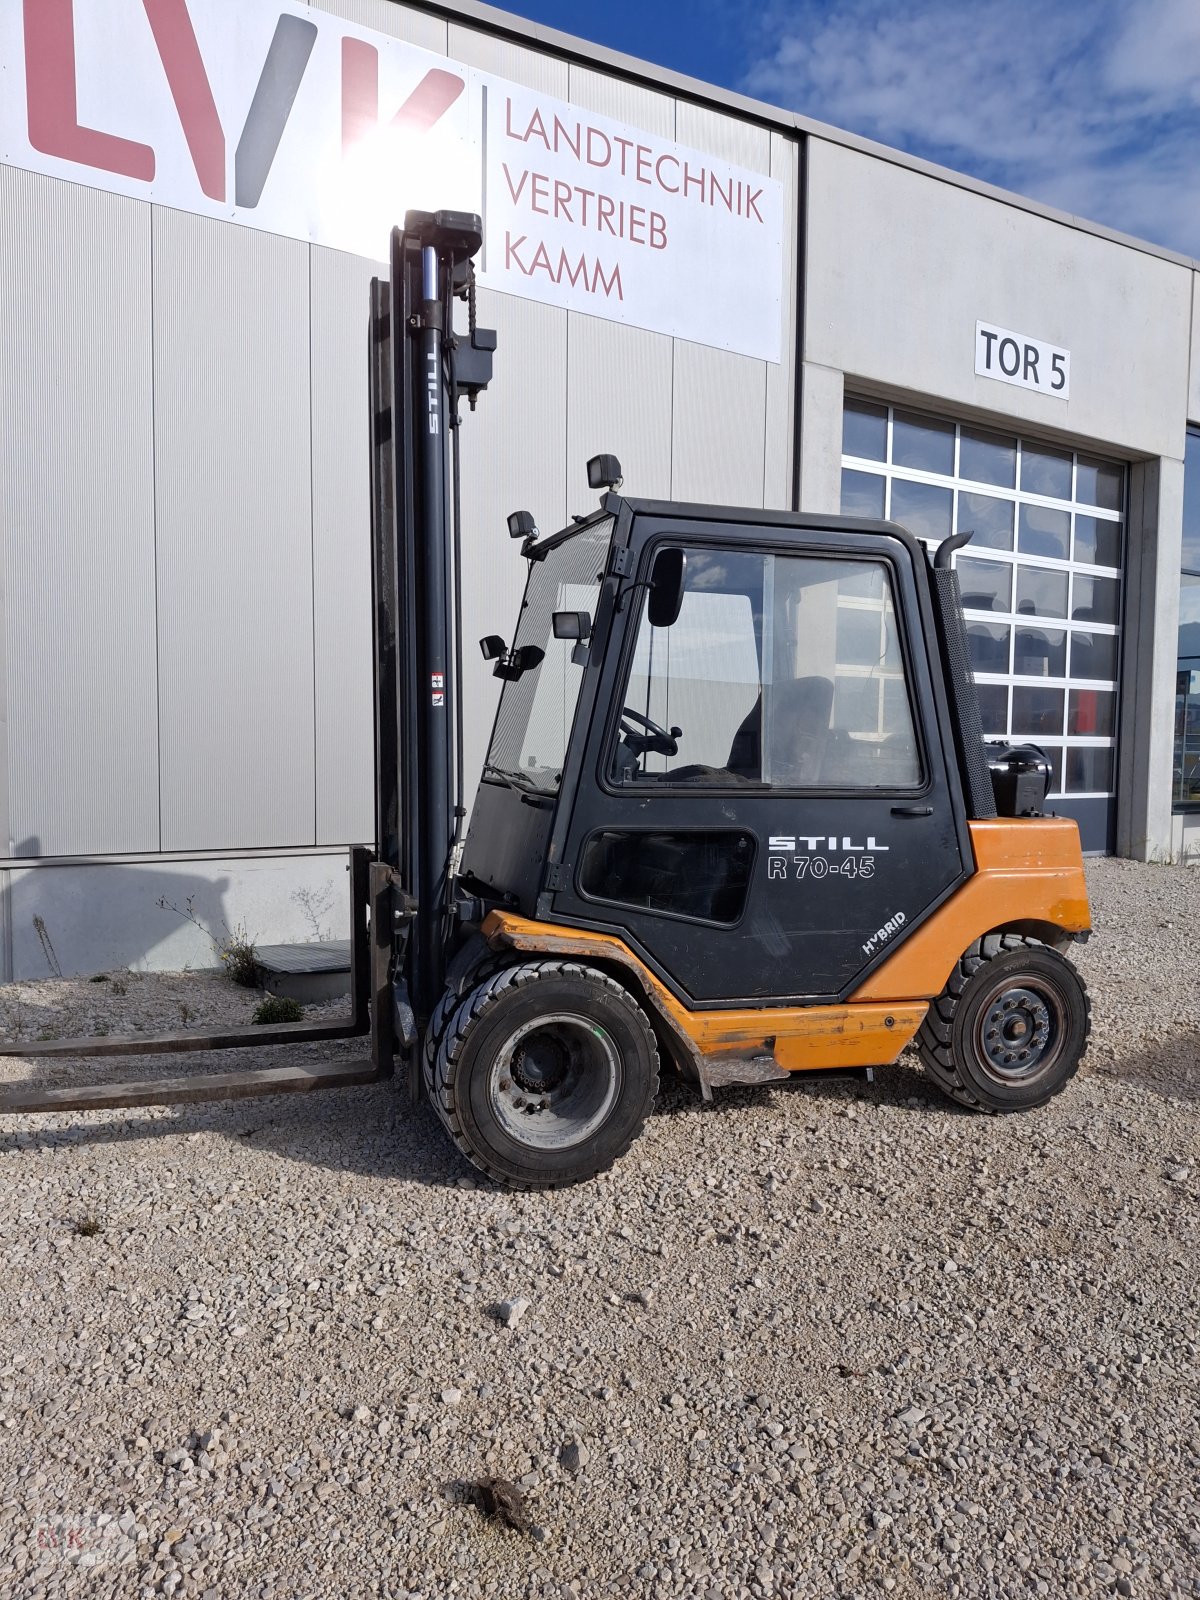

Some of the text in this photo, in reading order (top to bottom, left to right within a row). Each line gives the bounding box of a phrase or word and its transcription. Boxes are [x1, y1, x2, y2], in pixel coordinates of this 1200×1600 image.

[505, 96, 765, 224] LANDTECHNIK
[501, 162, 668, 250] VERTRIEB
[505, 230, 624, 301] KAMM
[427, 342, 439, 434] STILL
[980, 329, 1066, 390] TOR 5
[767, 856, 876, 879] R 70-45
[768, 836, 890, 851] STILL
[861, 911, 907, 956] HYBRID
